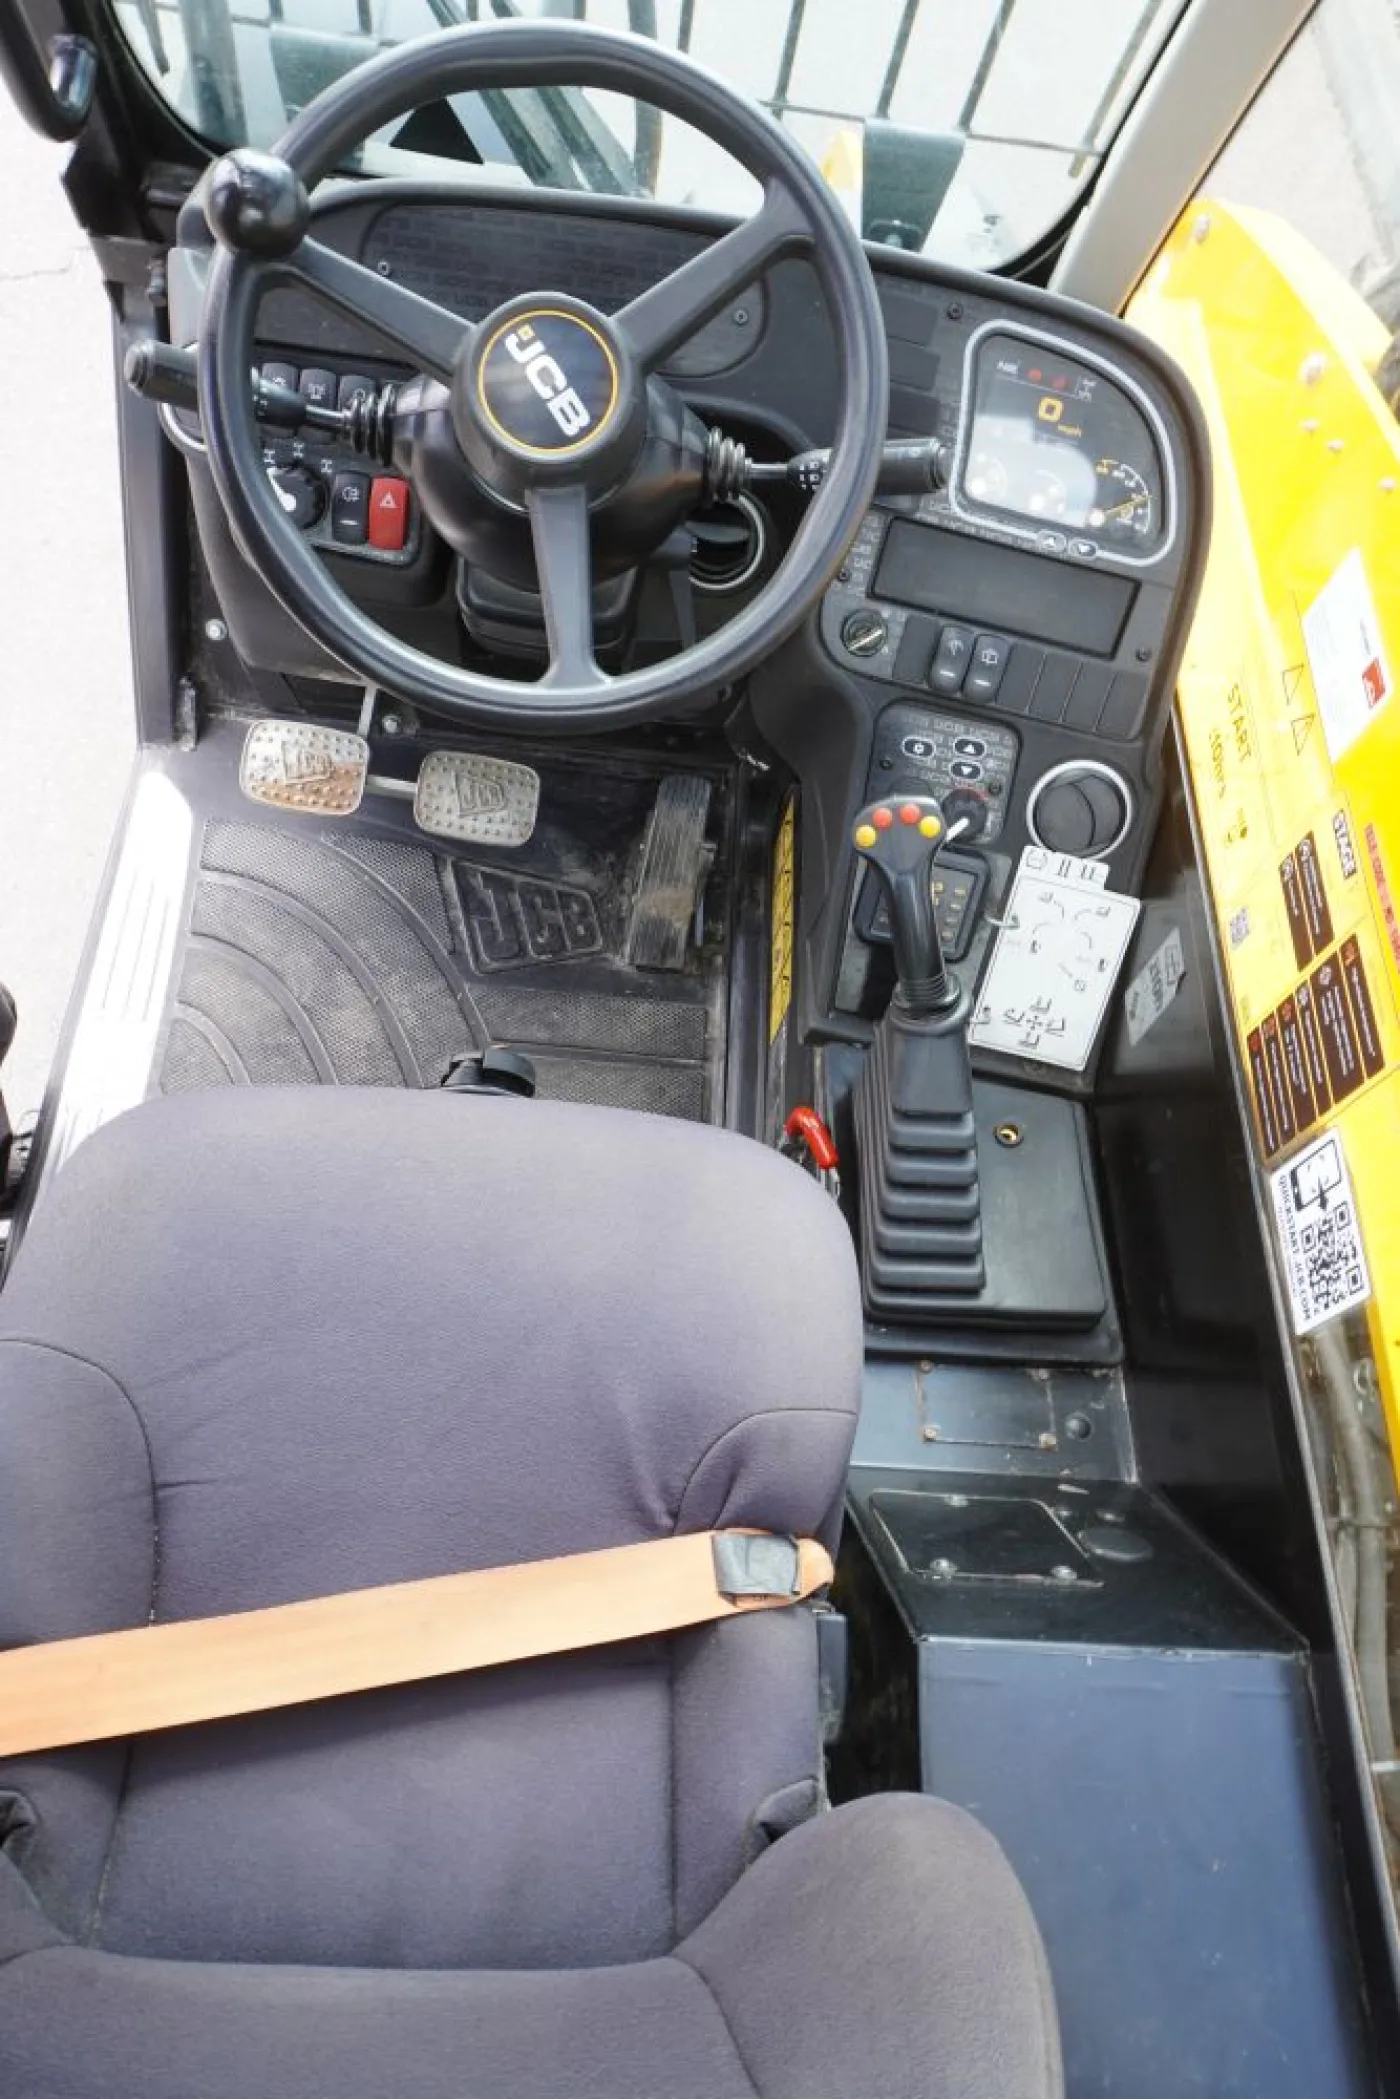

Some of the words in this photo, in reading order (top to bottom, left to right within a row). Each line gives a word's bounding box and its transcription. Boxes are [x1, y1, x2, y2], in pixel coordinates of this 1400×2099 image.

[505, 324, 590, 437] JCB
[1227, 682, 1251, 762] START
[467, 870, 603, 967] JCB
